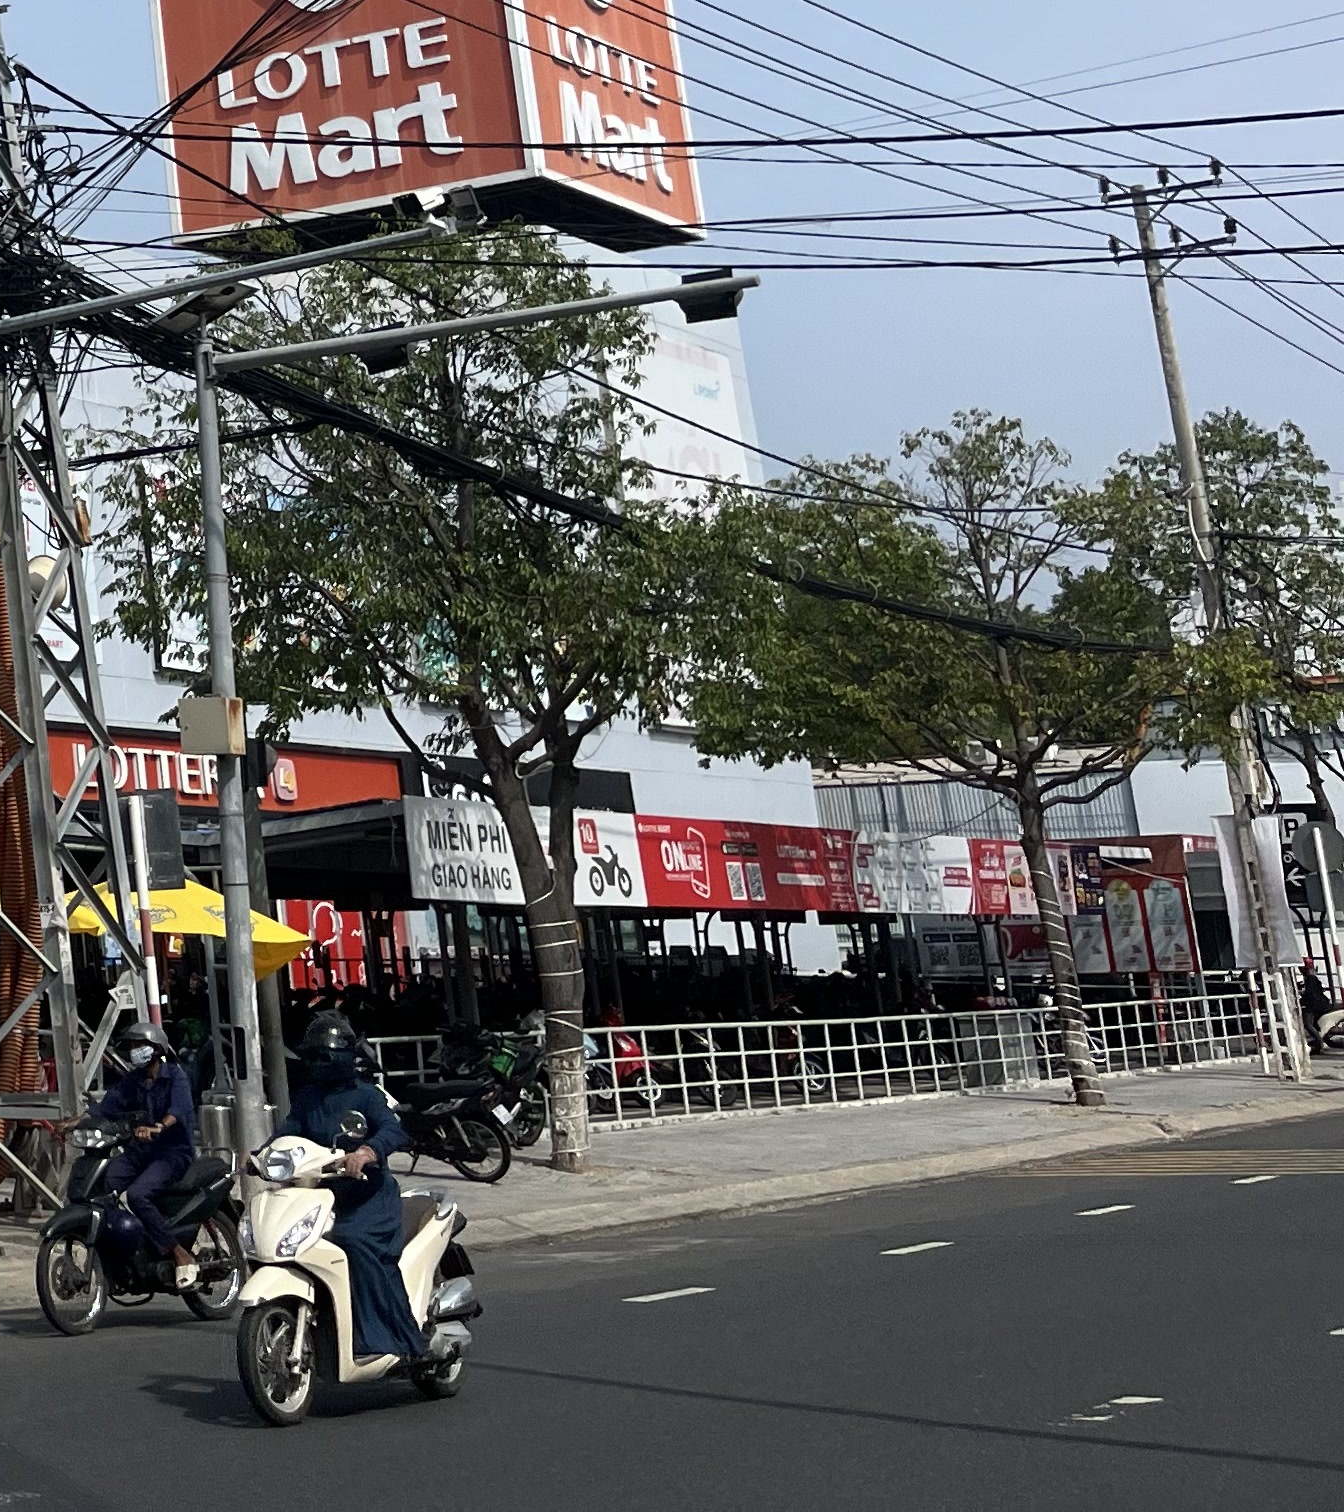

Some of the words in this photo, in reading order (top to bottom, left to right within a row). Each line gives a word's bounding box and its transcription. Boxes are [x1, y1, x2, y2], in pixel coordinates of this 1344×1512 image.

[216, 16, 452, 110] LOTTE
[544, 15, 660, 108] LOTTE
[229, 81, 464, 197] Mart
[560, 79, 675, 195] Mart
[72, 742, 265, 795] LOTTER
[1283, 818, 1299, 838] P
[431, 862, 468, 889] GIAO
[470, 859, 512, 891] HÀNG
